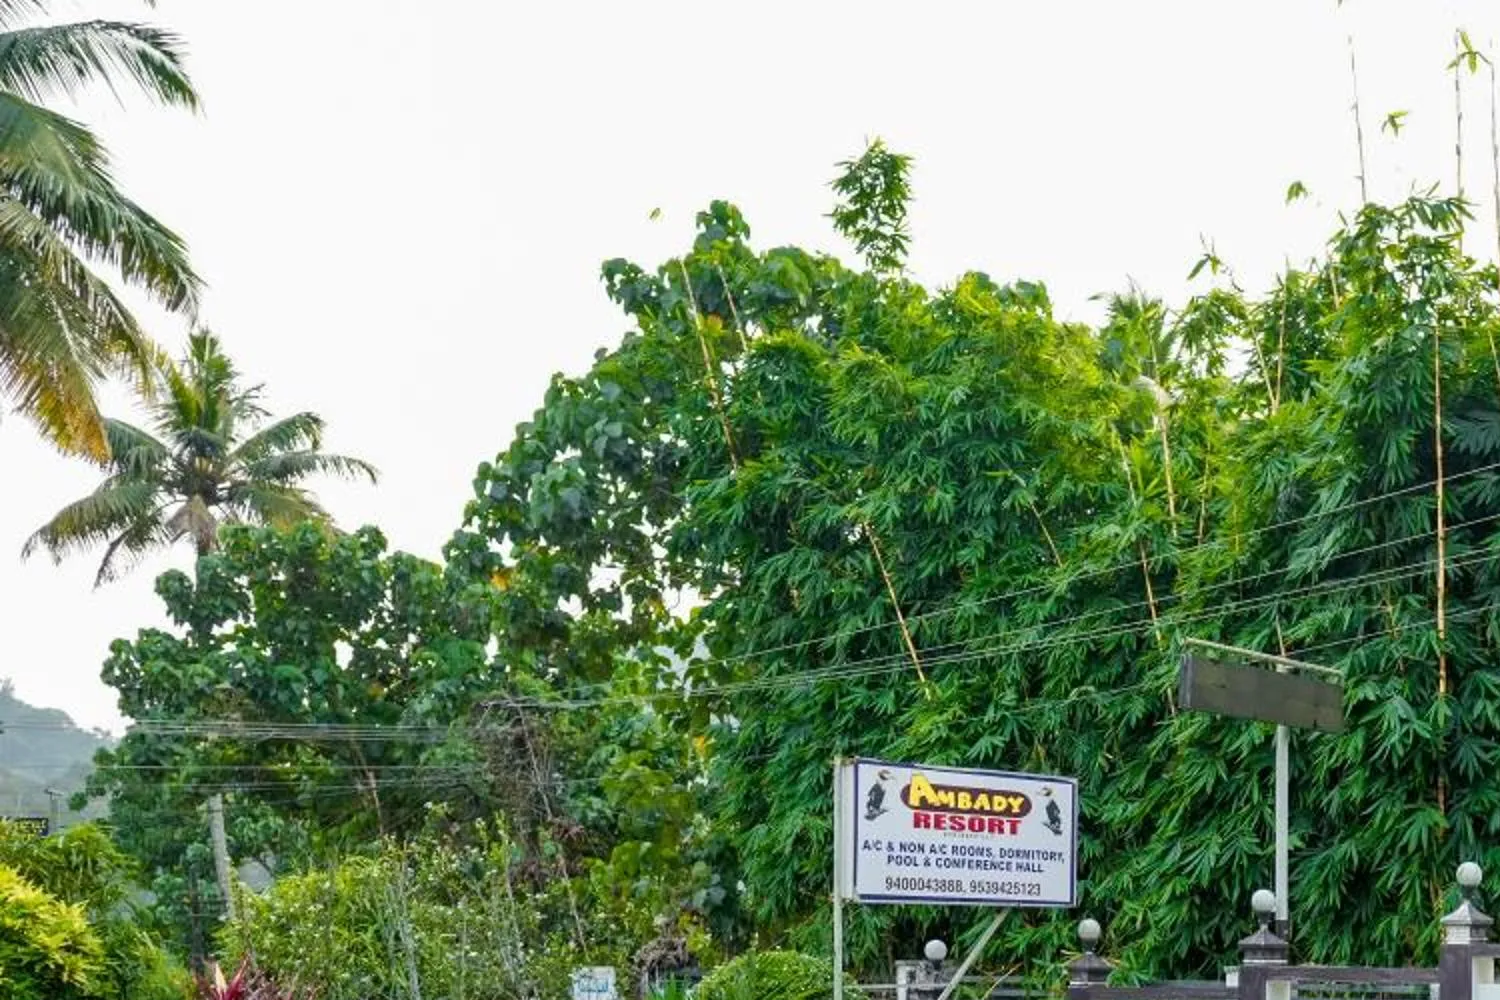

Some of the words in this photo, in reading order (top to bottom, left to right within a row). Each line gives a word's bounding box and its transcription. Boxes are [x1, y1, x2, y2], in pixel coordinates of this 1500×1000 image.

[908, 773, 1025, 812] AMBADY
[913, 811, 1022, 835] RESORT
[886, 841, 895, 852] &
[899, 842, 925, 854] NON
[887, 854, 919, 867] POOL
[923, 856, 931, 867] &
[935, 857, 1012, 873] CONFERENCE
[1015, 861, 1044, 873] HALL
